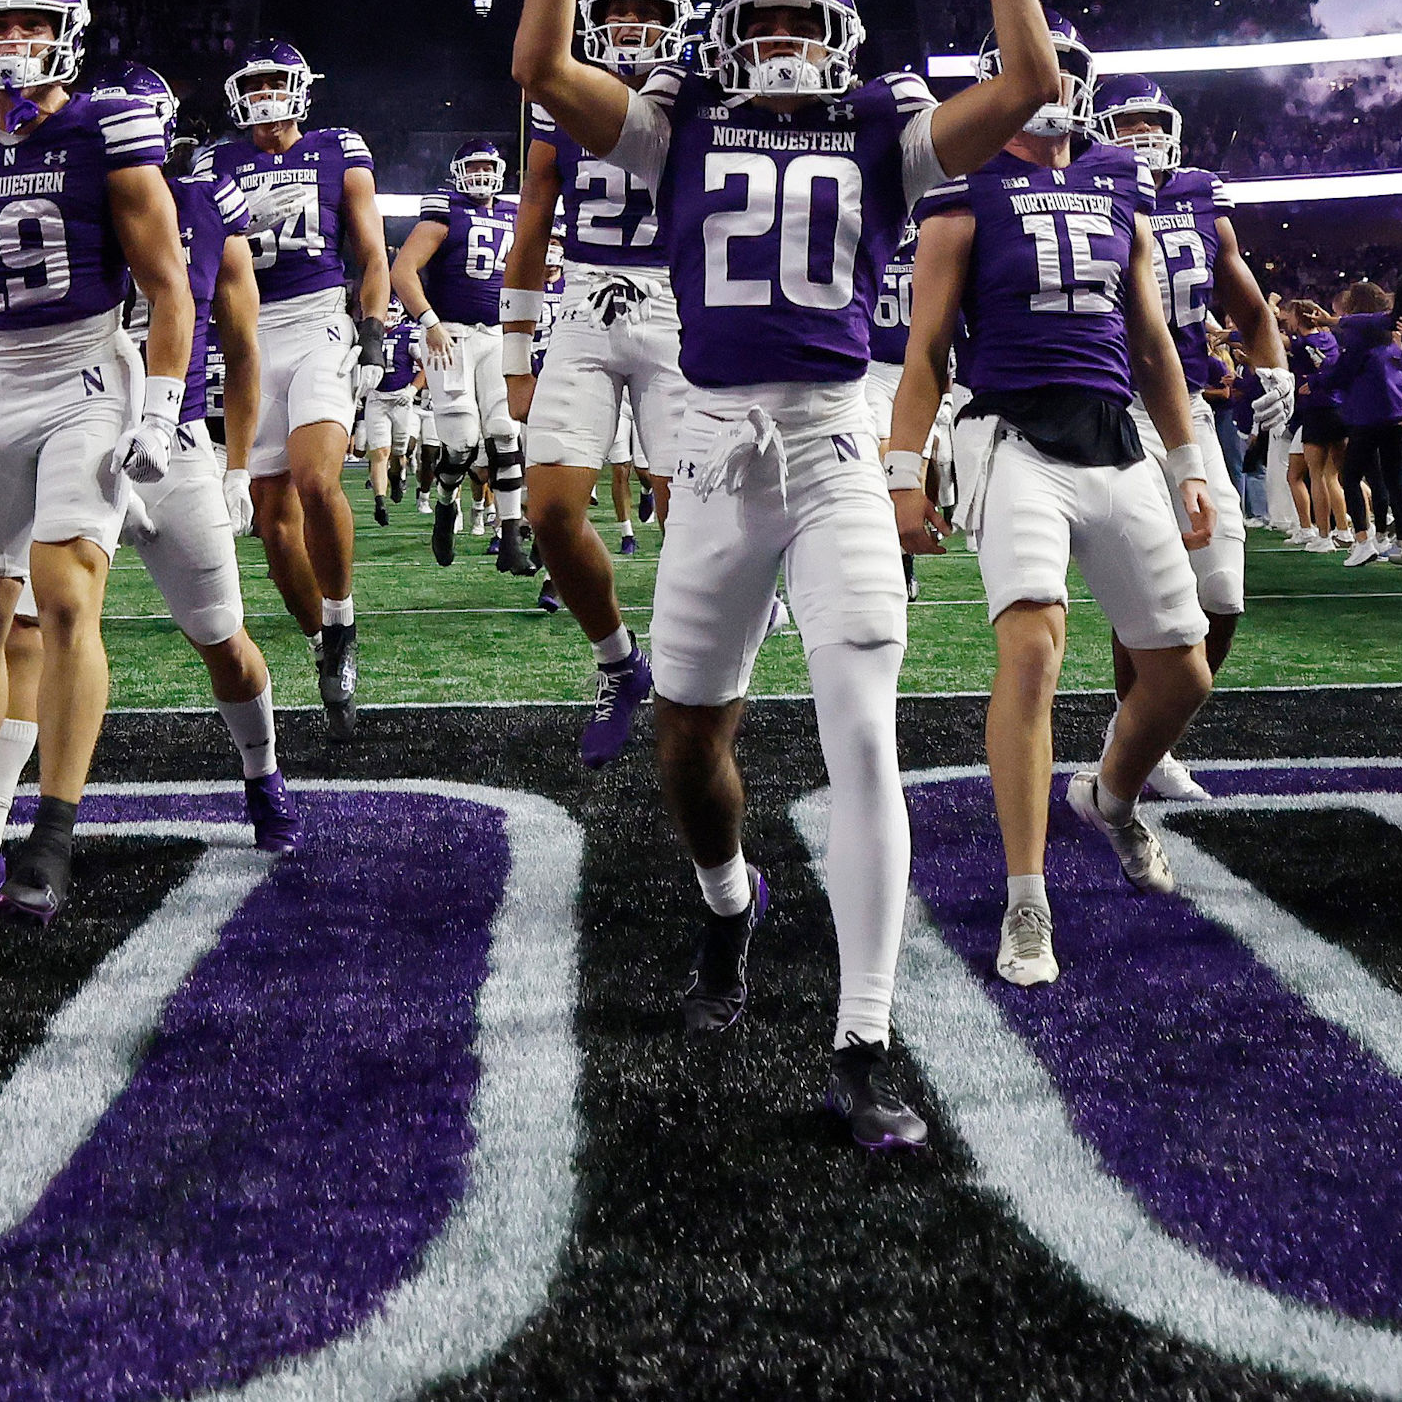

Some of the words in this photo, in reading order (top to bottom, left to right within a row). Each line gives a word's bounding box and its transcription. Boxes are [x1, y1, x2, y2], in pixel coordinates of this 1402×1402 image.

[713, 125, 856, 152] NORTHWESTERN
[3, 147, 16, 167] N
[1052, 169, 1066, 186] N
[574, 159, 659, 247] 27
[1010, 192, 1112, 216] NORTHWESTERN
[703, 151, 863, 310] 20
[1021, 213, 1122, 313] 15
[81, 366, 105, 396] N
[830, 432, 861, 464] N
